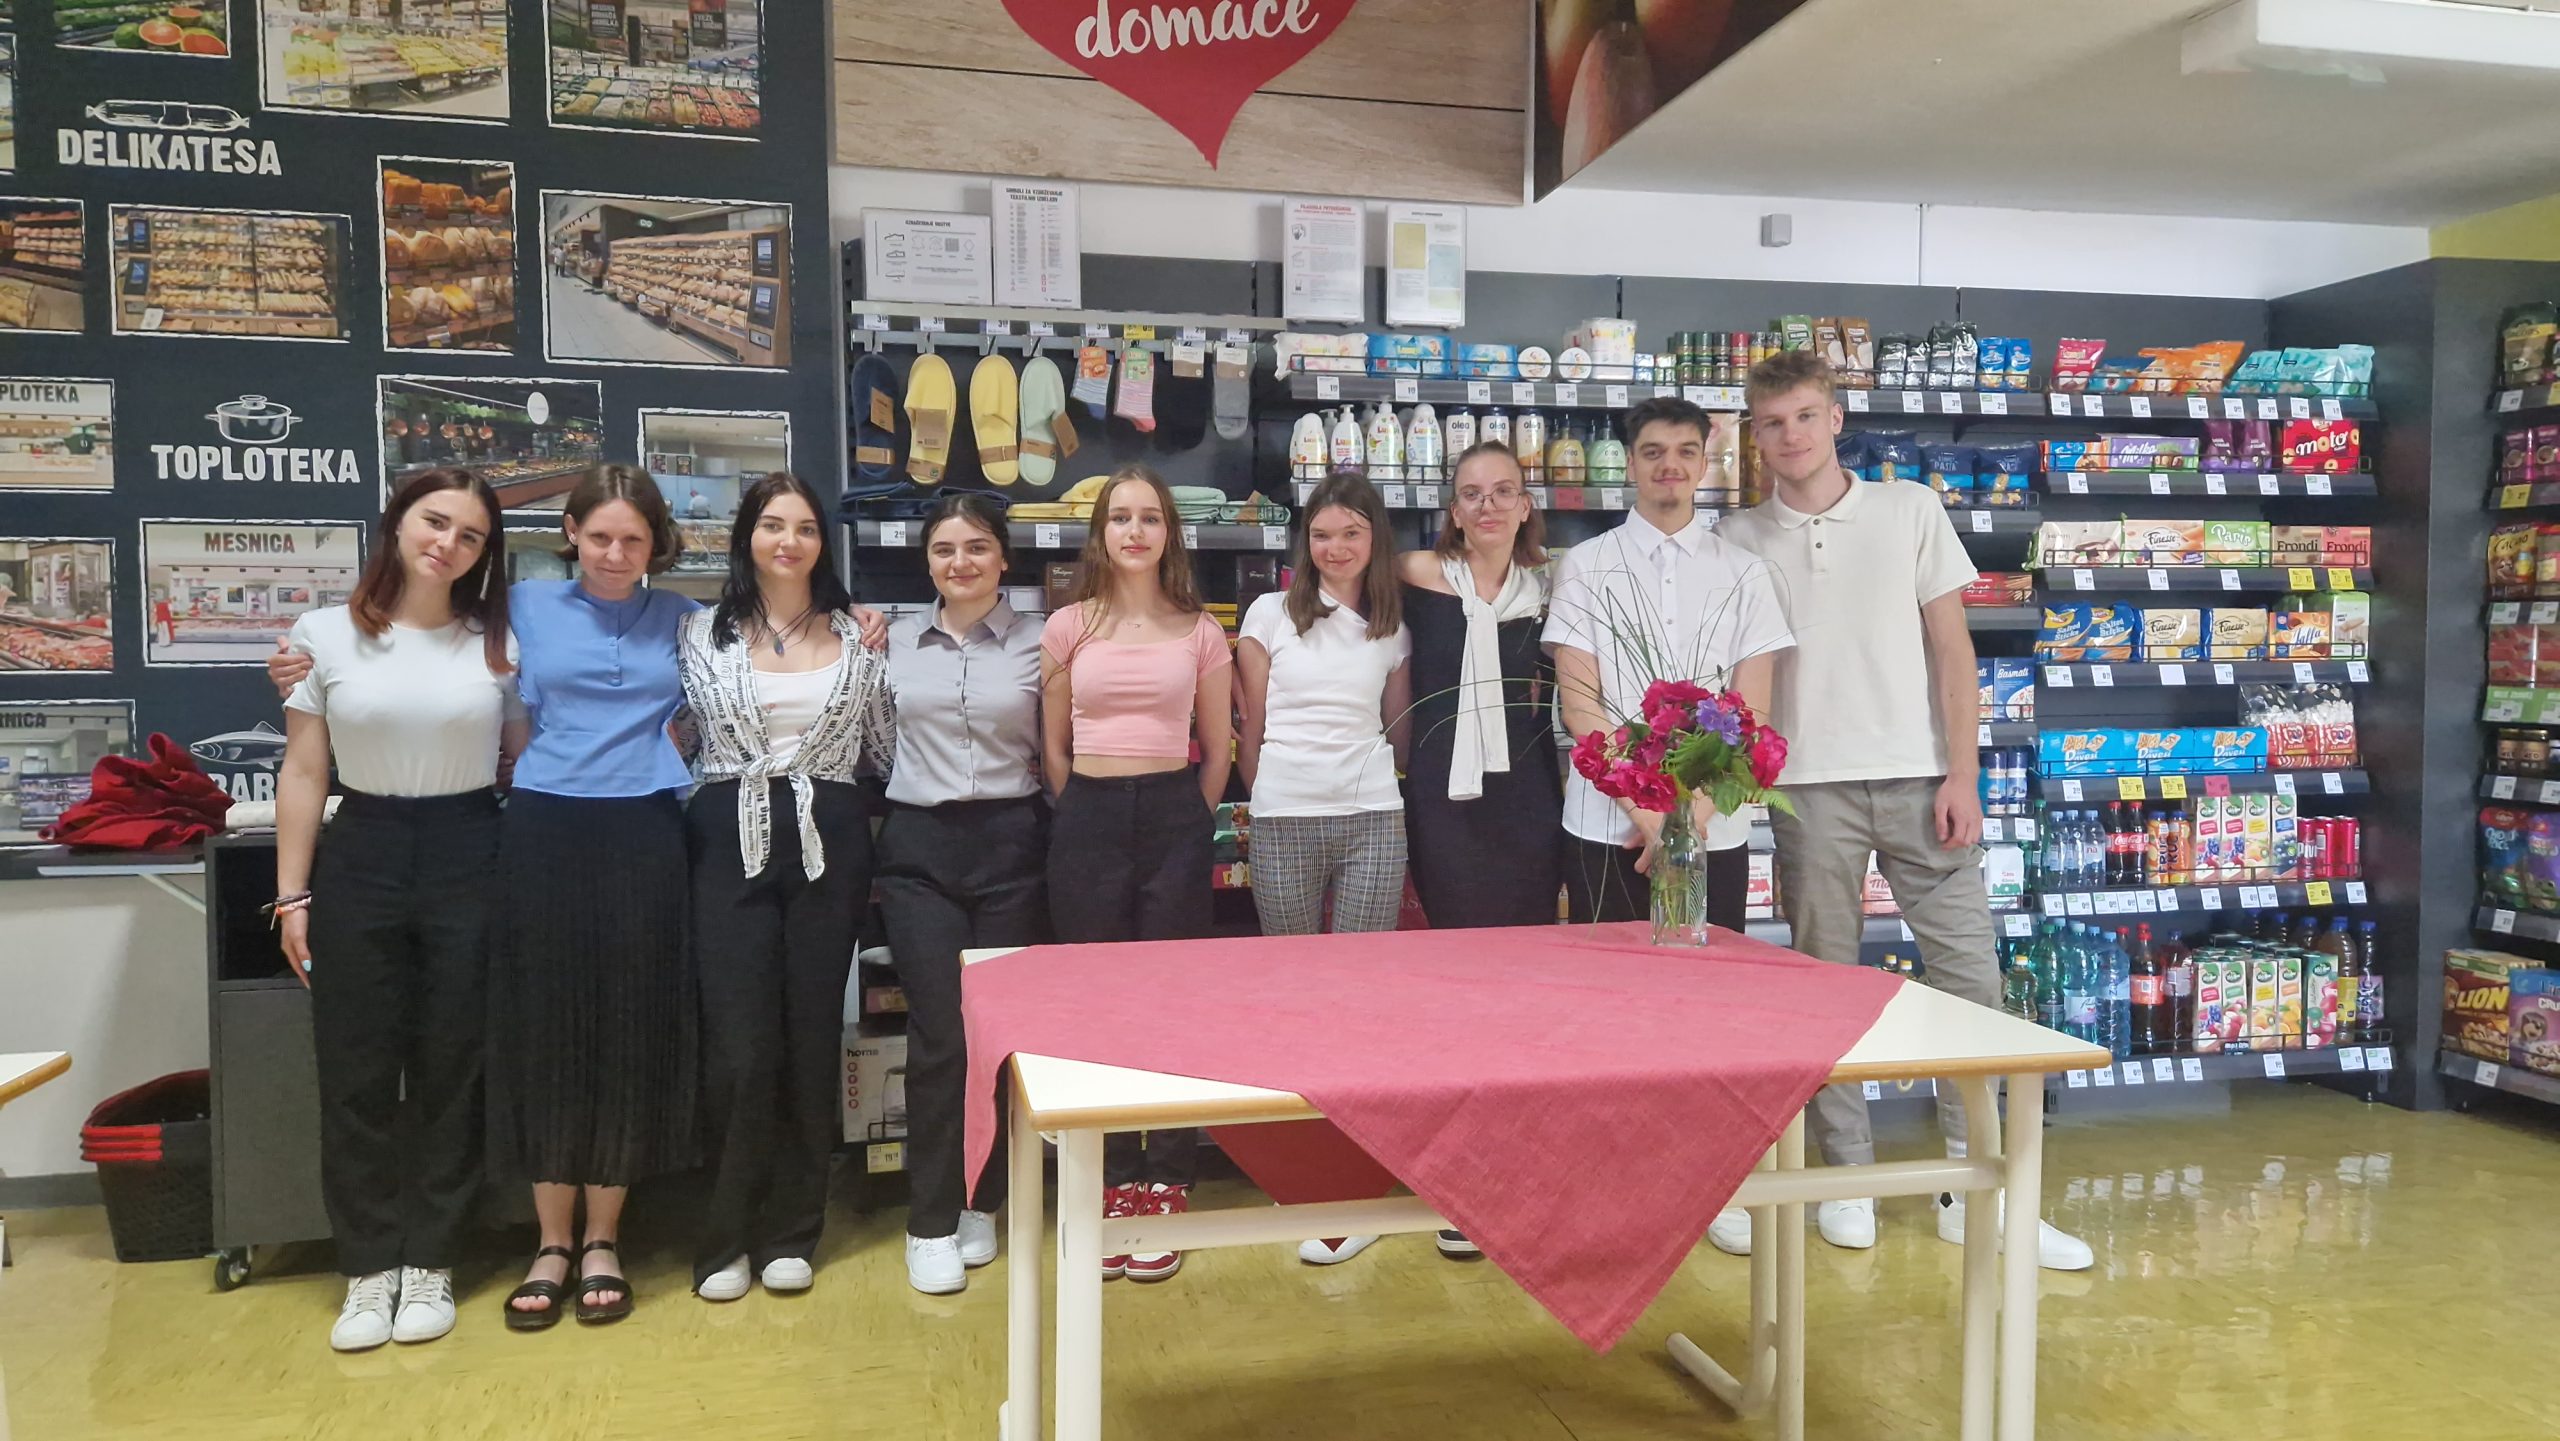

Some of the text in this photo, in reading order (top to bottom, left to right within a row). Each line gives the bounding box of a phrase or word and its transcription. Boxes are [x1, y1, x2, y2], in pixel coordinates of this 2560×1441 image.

[57, 128, 283, 177] DELIKATESA
[150, 444, 361, 483] TOPLOTEKA
[2119, 442, 2158, 465] Milka
[204, 532, 296, 554] MESNICA
[2211, 524, 2252, 546] Paris
[1997, 667, 2029, 679] Basmati
[2455, 985, 2509, 1011] LION
